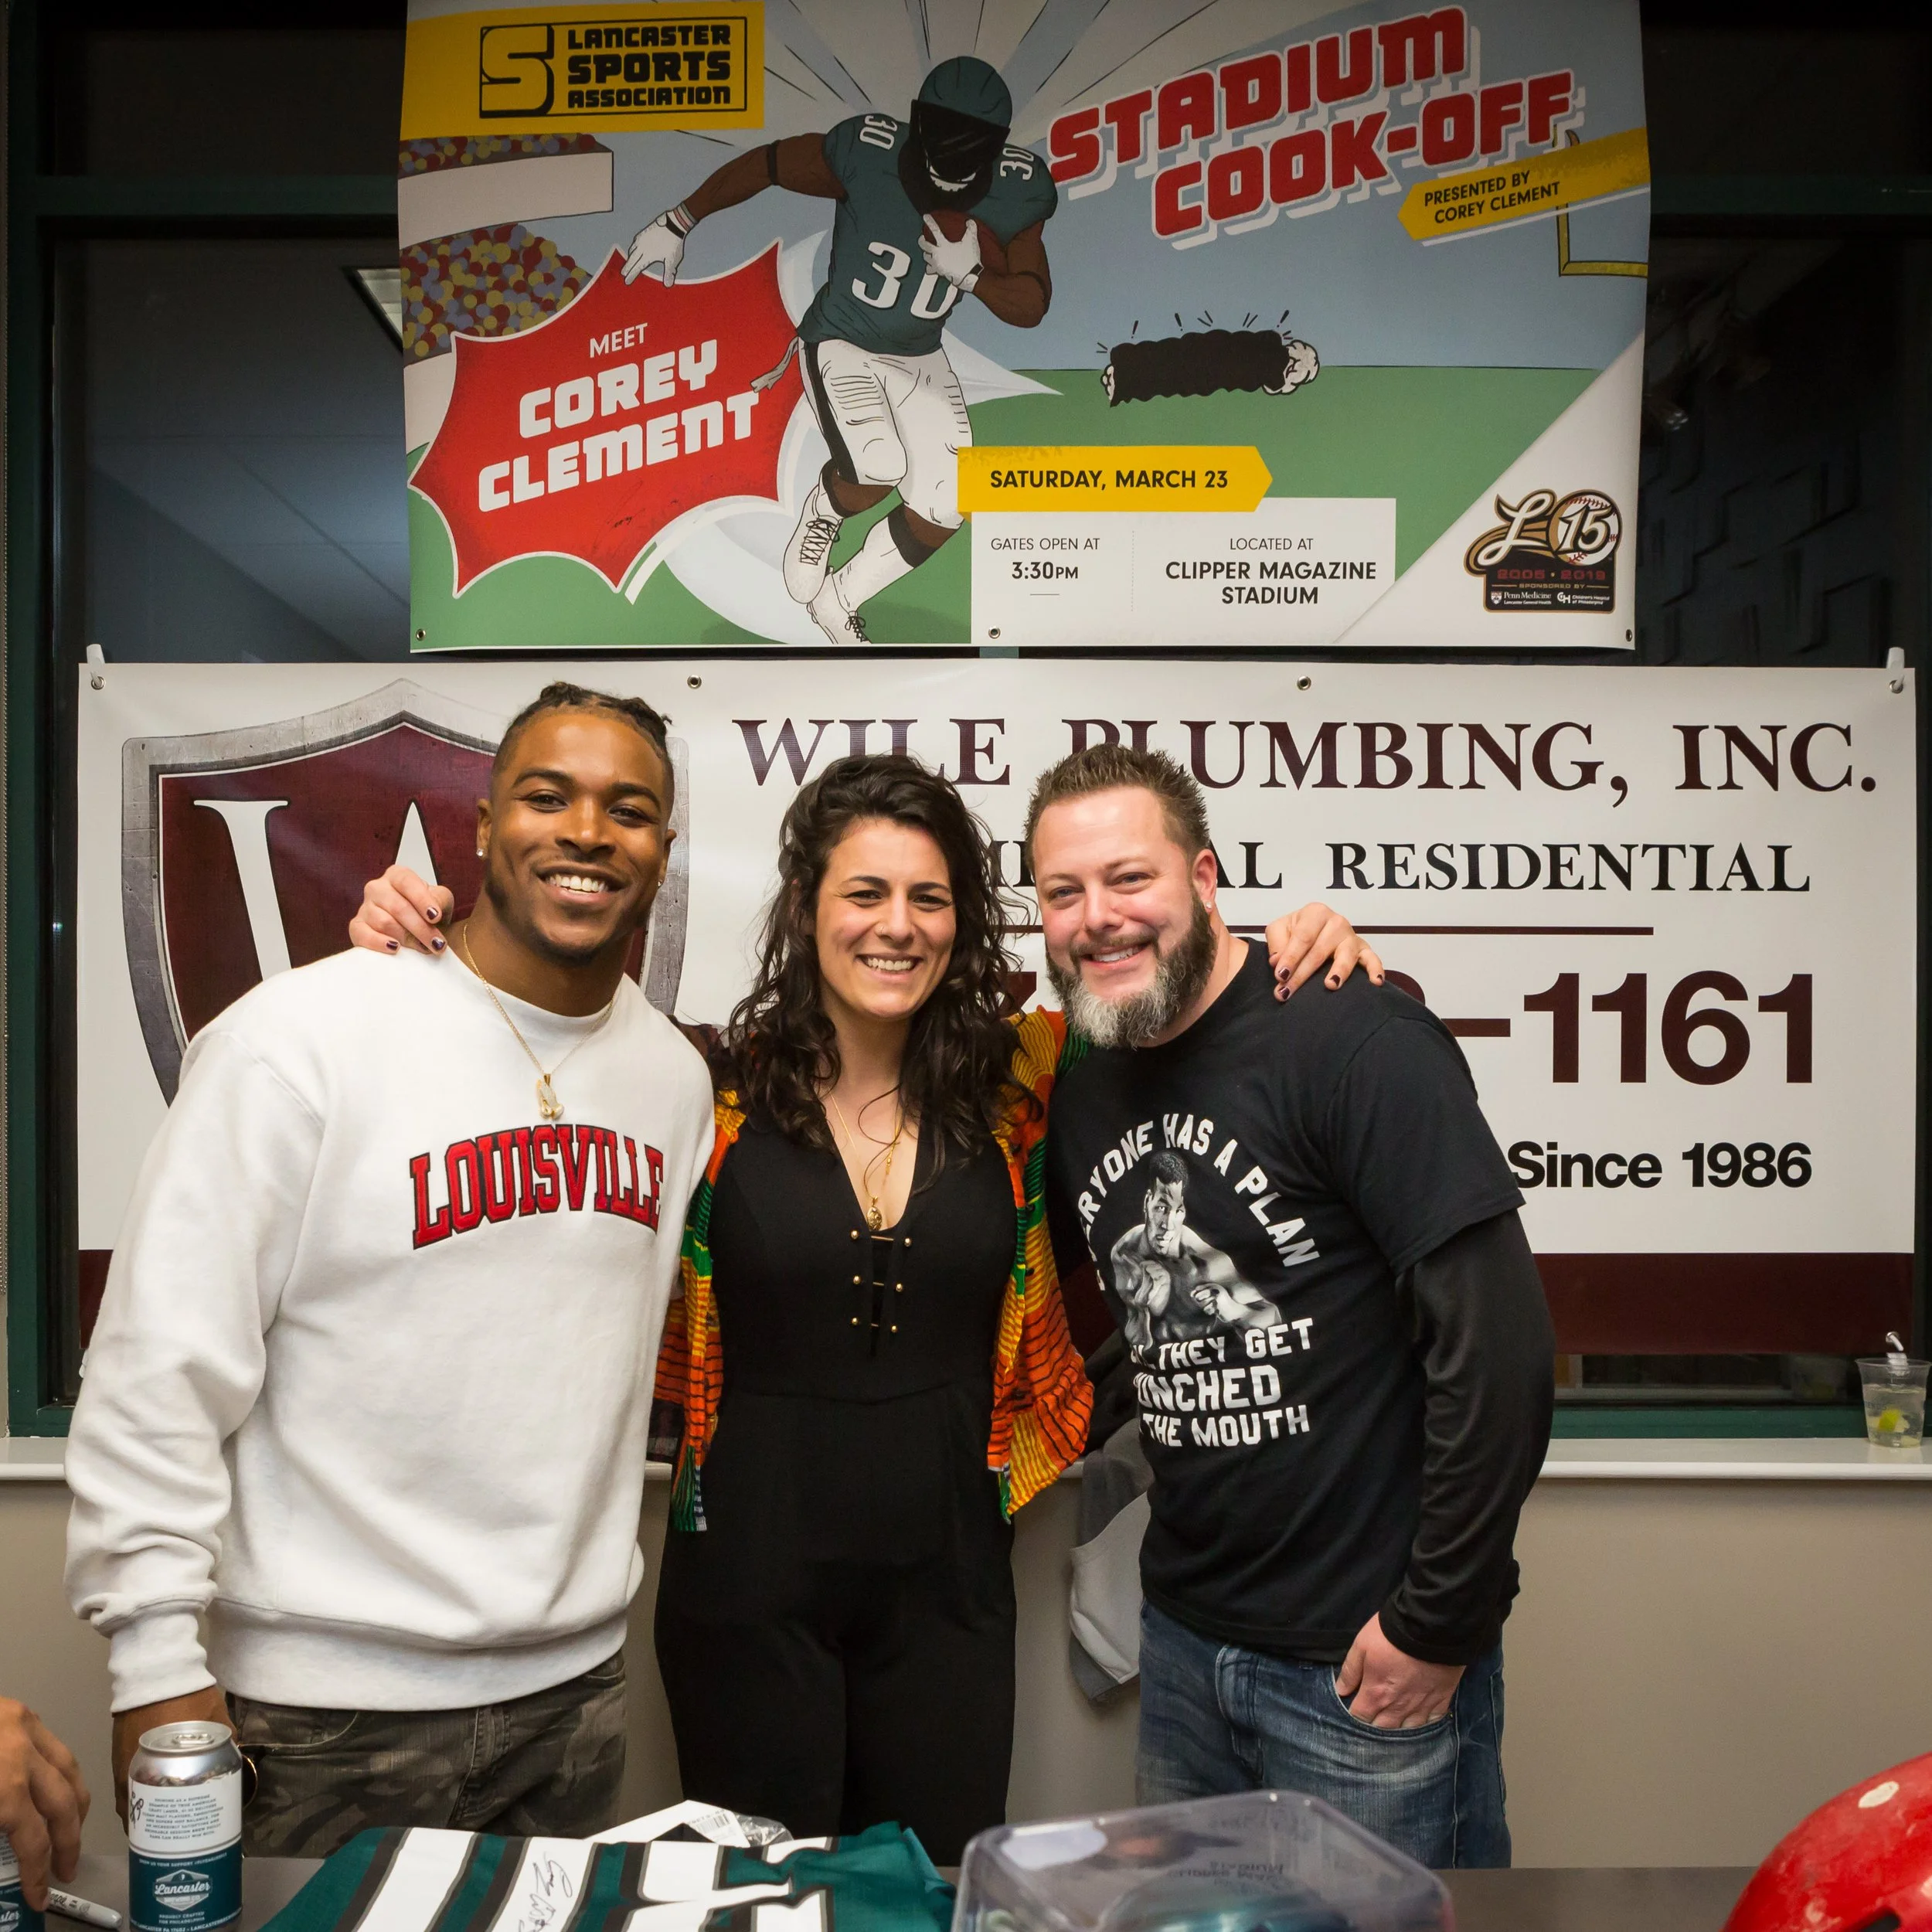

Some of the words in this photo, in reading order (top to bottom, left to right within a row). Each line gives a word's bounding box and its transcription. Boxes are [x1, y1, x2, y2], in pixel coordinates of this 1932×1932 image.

[567, 25, 731, 49] LANCASTER
[567, 51, 731, 84] SPORTS
[567, 86, 731, 108] ASSOCIATION
[1048, 6, 1468, 185] STADIUM
[1151, 70, 1575, 238] COOK-OFF
[1424, 176, 1506, 207] PRESENTED
[1512, 169, 1531, 188] BY
[1434, 199, 1485, 223] COREY
[1490, 181, 1560, 211] CLEMENT
[589, 322, 648, 359] MEET
[519, 338, 718, 439] COREY
[478, 390, 760, 512] CLEMENT
[990, 470, 1107, 491] SATURDAY,
[1115, 470, 1196, 488] MARCH
[1204, 470, 1229, 488] 23
[991, 538, 1034, 550] GATES
[1039, 538, 1078, 550] OPEN
[1083, 538, 1100, 550] AT
[1230, 538, 1291, 550] LOCATED
[1296, 538, 1314, 550] AT
[1559, 504, 1612, 552] 15
[1011, 561, 1079, 580] 3:30PM
[1165, 562, 1250, 580] CLIPPER
[1260, 563, 1376, 580] MAGAZINE
[1222, 587, 1318, 604] STADIUM
[1521, 591, 1552, 600] Medicine
[1672, 722, 1878, 793] INC.
[1325, 842, 1811, 892] RESIDENTIAL
[1509, 1140, 1663, 1189] Since
[1682, 1141, 1812, 1188] 1986
[408, 1123, 665, 1250] LOUISVILLE
[1162, 1113, 1215, 1156] HAS
[1213, 1138, 1238, 1177] A
[1234, 1165, 1321, 1267] PLAN
[1158, 1335, 1226, 1371] THEY
[1245, 1318, 1314, 1359] GET
[1141, 1413, 1182, 1447] THE
[1190, 1404, 1311, 1447] MOUTH
[155, 1881, 210, 1895] Lancaster
